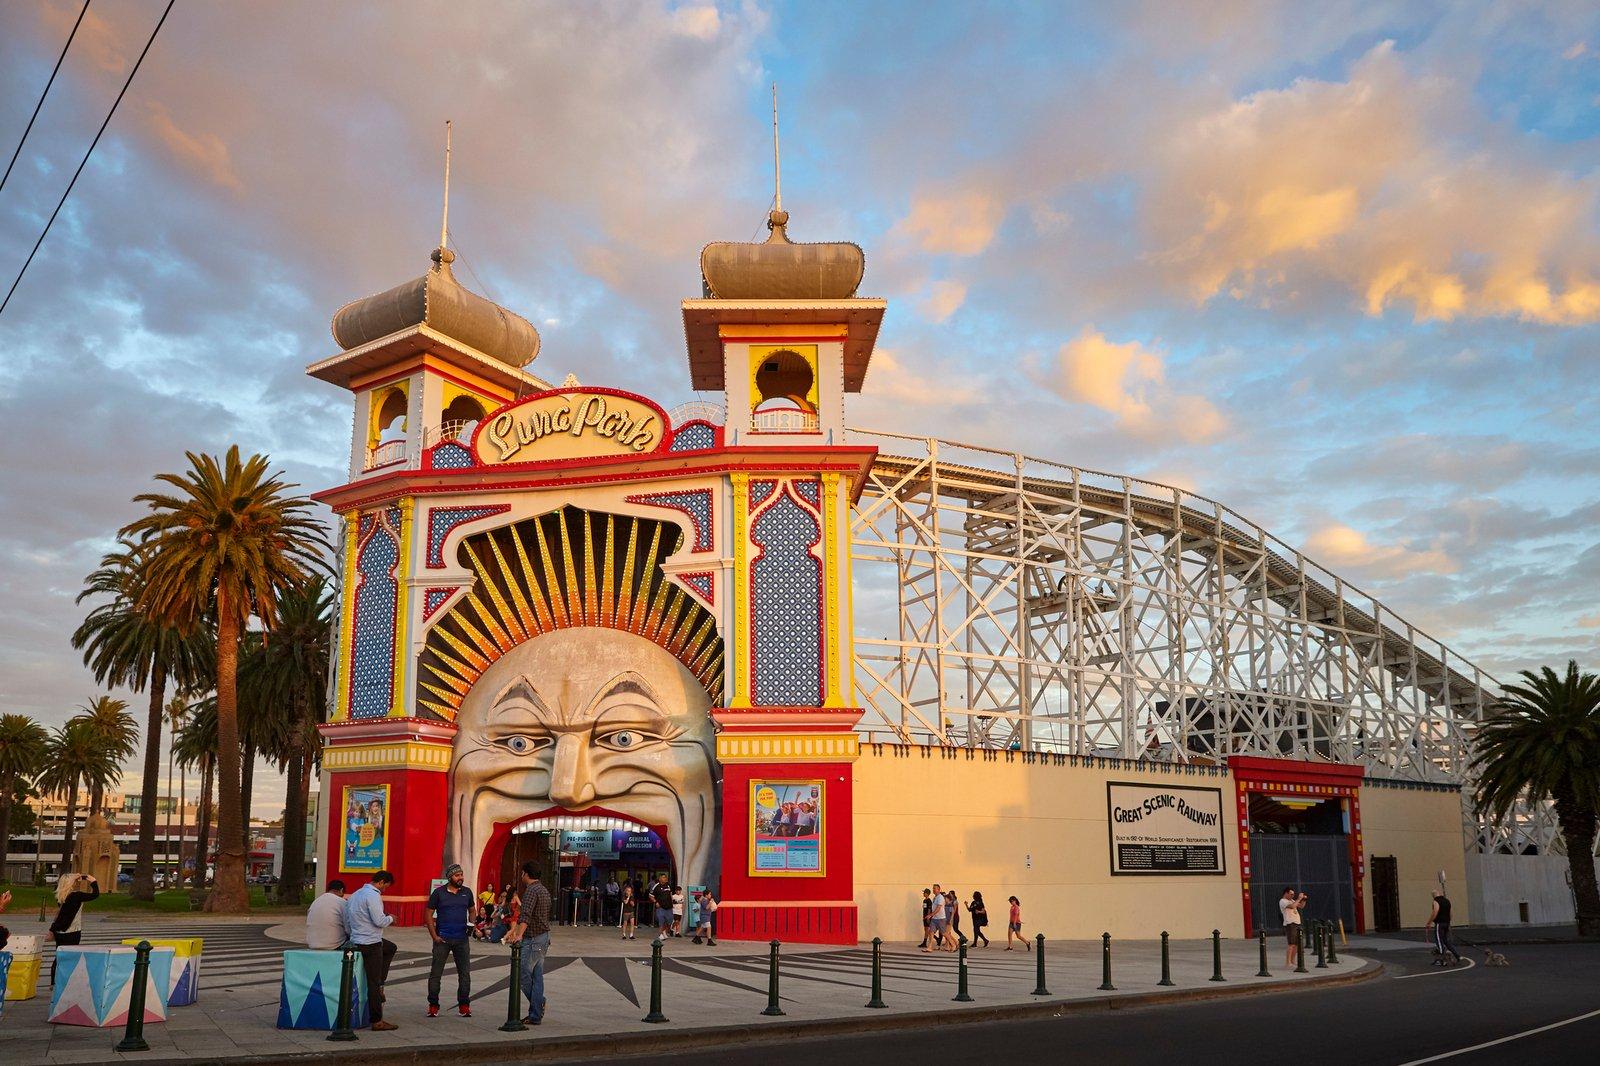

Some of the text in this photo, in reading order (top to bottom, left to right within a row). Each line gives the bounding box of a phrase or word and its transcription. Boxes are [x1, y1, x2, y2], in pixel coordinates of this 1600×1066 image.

[489, 394, 655, 461] Luna Park
[1114, 794, 1217, 826] GREAT SCENIC RAILWAY
